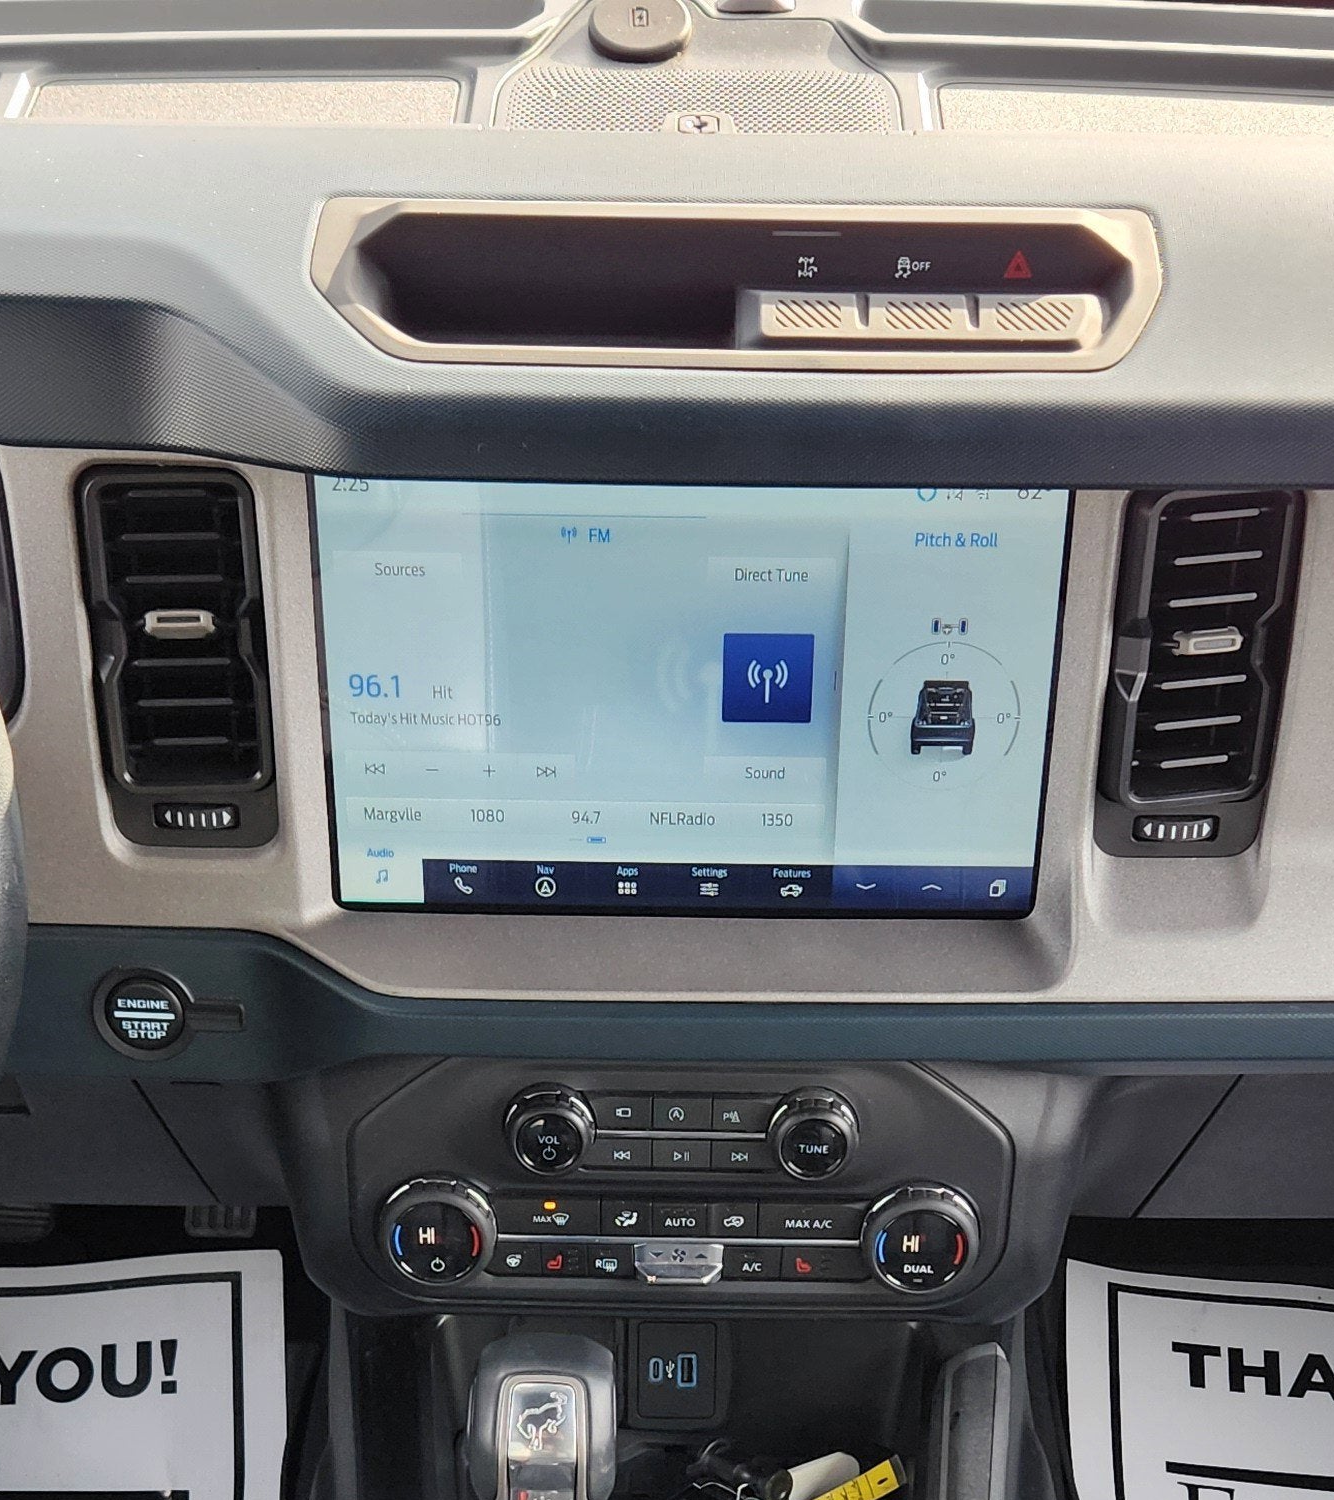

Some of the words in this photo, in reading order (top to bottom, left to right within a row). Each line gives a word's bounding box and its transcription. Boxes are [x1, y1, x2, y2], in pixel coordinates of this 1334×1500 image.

[911, 260, 931, 272] OFF
[332, 477, 369, 492] 2:25
[588, 528, 611, 543] FM
[915, 532, 951, 547] Pitch
[955, 533, 966, 547] &
[970, 532, 998, 548] Roll
[374, 562, 426, 577] Sources
[734, 567, 772, 582] Direct
[776, 568, 809, 583] Tune
[349, 674, 400, 698] 96.1
[432, 685, 453, 700] Hit
[350, 711, 397, 726] Today's
[400, 713, 418, 725] Hit
[421, 713, 455, 726] Music
[457, 713, 501, 727] HOT96
[745, 766, 785, 780] Sound
[364, 807, 422, 824] Margvlle
[471, 809, 505, 823] 1080
[571, 810, 601, 824] 94.7
[650, 811, 716, 826] NFLRadio
[762, 813, 793, 827] 1350
[367, 848, 395, 858] Audio
[449, 863, 478, 874] Phone
[536, 864, 555, 875] Nav
[617, 866, 639, 877] Apps
[691, 866, 728, 878] Settings
[773, 868, 812, 879] Features
[117, 998, 169, 1010] ENGINE
[122, 1020, 170, 1031] START
[128, 1029, 167, 1039] STOP
[537, 1135, 560, 1146] VOL
[798, 1144, 829, 1155] TUNE
[533, 1215, 553, 1224] MAX
[664, 1217, 696, 1227] AUTO
[785, 1219, 810, 1229] MAX
[812, 1220, 833, 1230] A/C
[418, 1226, 436, 1245] HI
[902, 1234, 920, 1253] HI
[742, 1262, 762, 1273] A/C
[903, 1264, 934, 1275] DUAL
